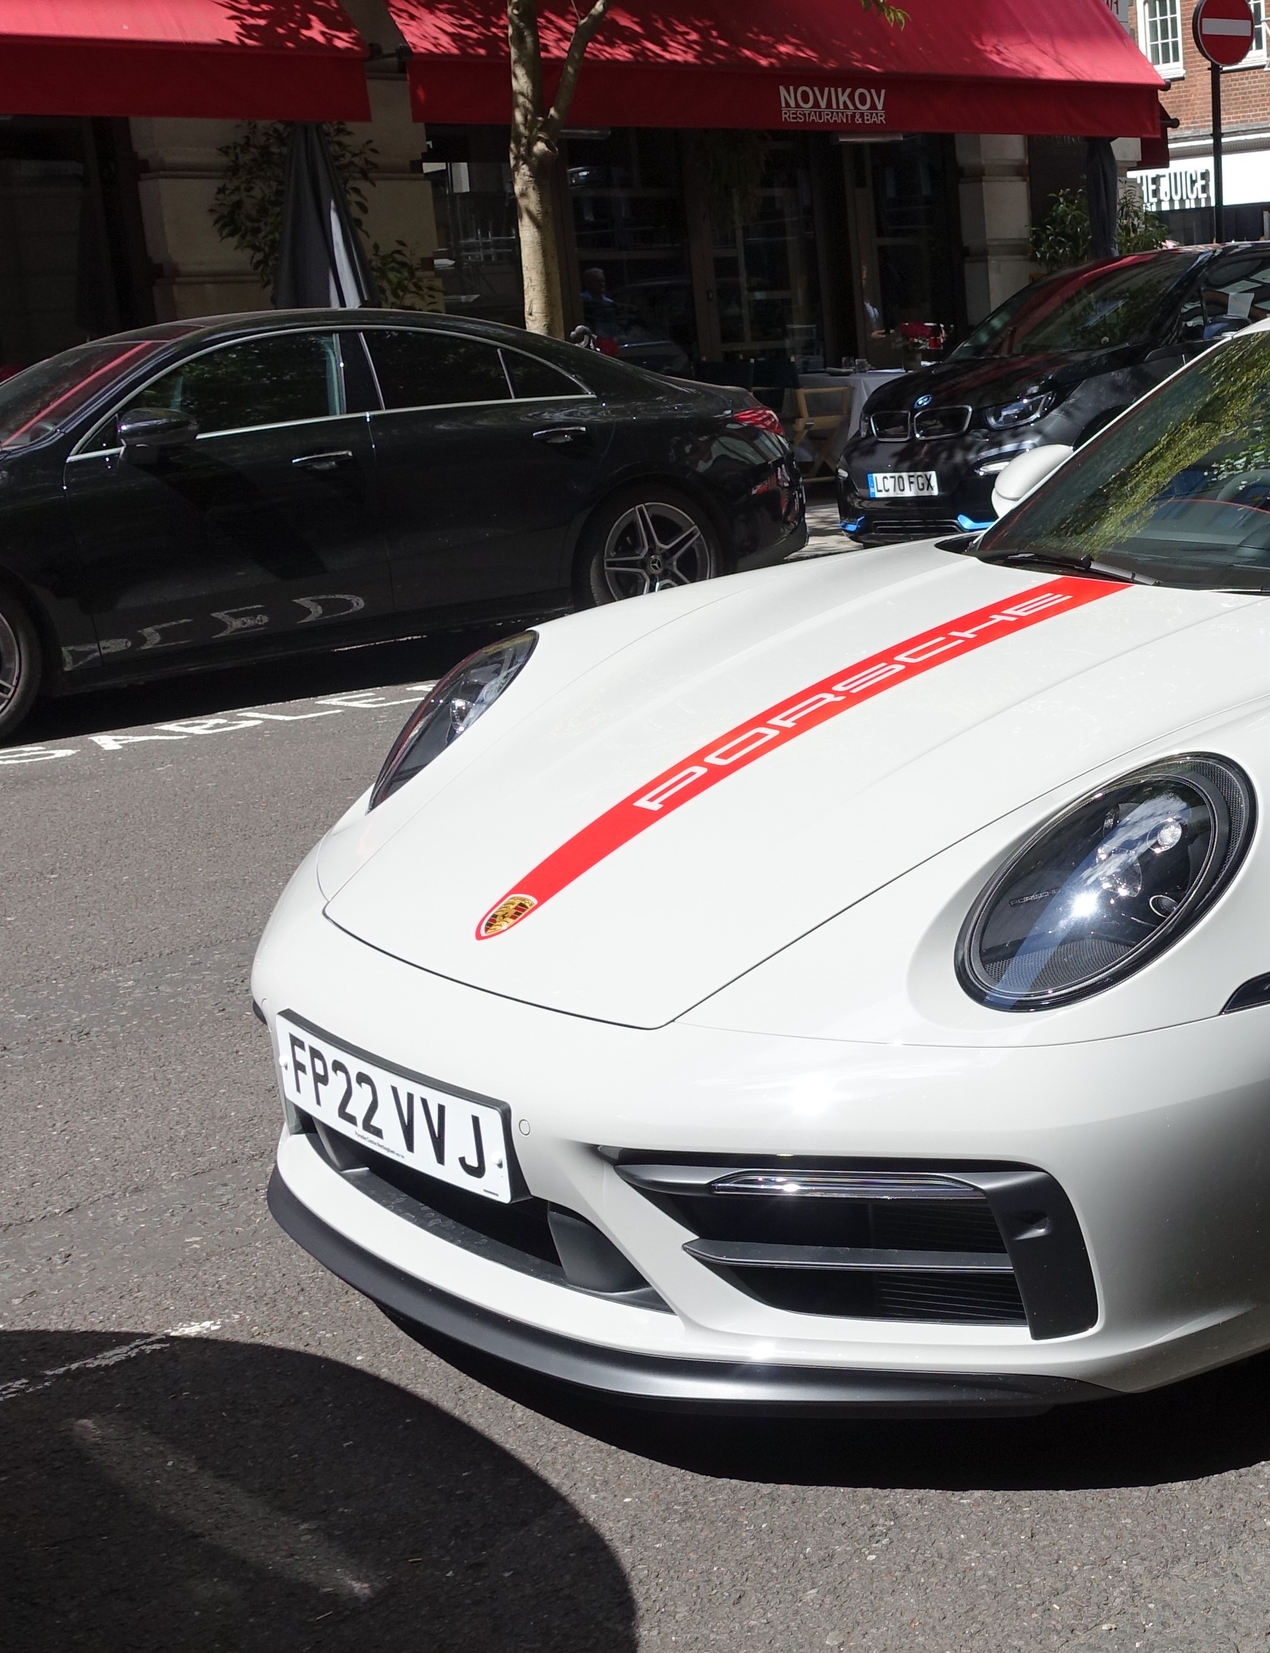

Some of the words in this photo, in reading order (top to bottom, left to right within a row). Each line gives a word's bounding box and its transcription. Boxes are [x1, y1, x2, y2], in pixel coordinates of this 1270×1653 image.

[779, 85, 886, 110] NOVIKOV
[782, 110, 853, 123] RESTAURANT
[854, 112, 862, 123] &
[864, 112, 886, 124] BAR
[1159, 169, 1208, 202] JUICE
[874, 474, 906, 493] LC70
[908, 473, 934, 492] FGX
[633, 592, 1073, 812] PORSCHE
[289, 1032, 384, 1140] FP22
[390, 1085, 486, 1179] VVJ
